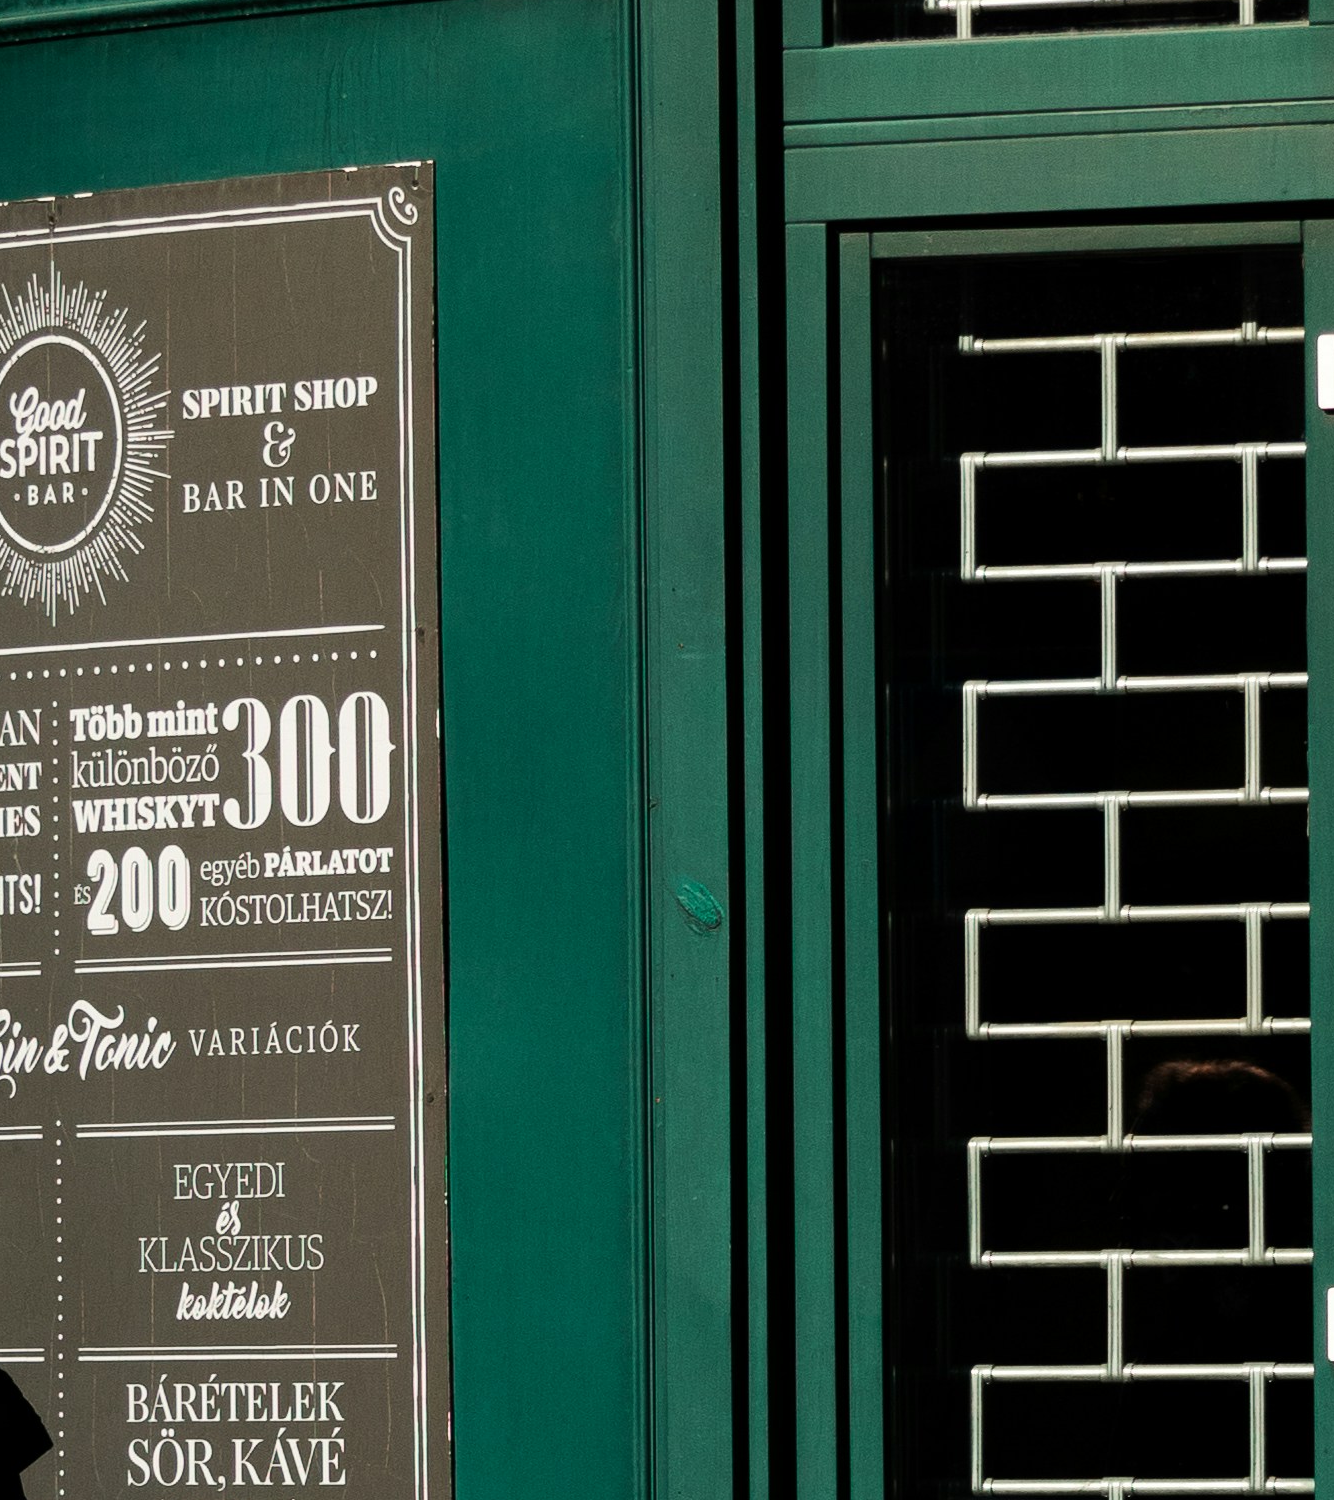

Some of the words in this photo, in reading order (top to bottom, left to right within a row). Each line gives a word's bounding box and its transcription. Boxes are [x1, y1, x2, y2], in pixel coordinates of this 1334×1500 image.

[10, 386, 87, 436] Good
[180, 383, 287, 420] SPIRIT
[294, 376, 378, 411] SHOP
[0, 431, 104, 479] SPIRIT
[263, 421, 296, 467] &
[27, 481, 75, 506] BAR
[182, 479, 247, 514] BAR
[259, 475, 295, 508] IN
[308, 469, 379, 504] ONE
[69, 703, 143, 742] Több
[146, 699, 220, 738] mint
[70, 743, 220, 789] különböző
[221, 691, 397, 830] 300
[71, 793, 221, 835] WHISKYT
[199, 851, 261, 887] egyéb
[263, 845, 394, 879] PÁRLATOT
[73, 884, 91, 906] ÉS
[86, 844, 191, 936] 200
[199, 889, 393, 927] KÓSTOLHATSZ!
[44, 1023, 70, 1074] &
[67, 999, 177, 1081] Tonic
[187, 1019, 361, 1057] VARIÁCIÓK
[173, 1162, 286, 1200] EGYEDI
[215, 1200, 242, 1235] és
[138, 1234, 325, 1273] KLASSZIKUS
[125, 1373, 345, 1423] BÁRÉTELEK
[126, 1427, 226, 1492] SÖR,
[230, 1426, 347, 1487] KÁVÉ
